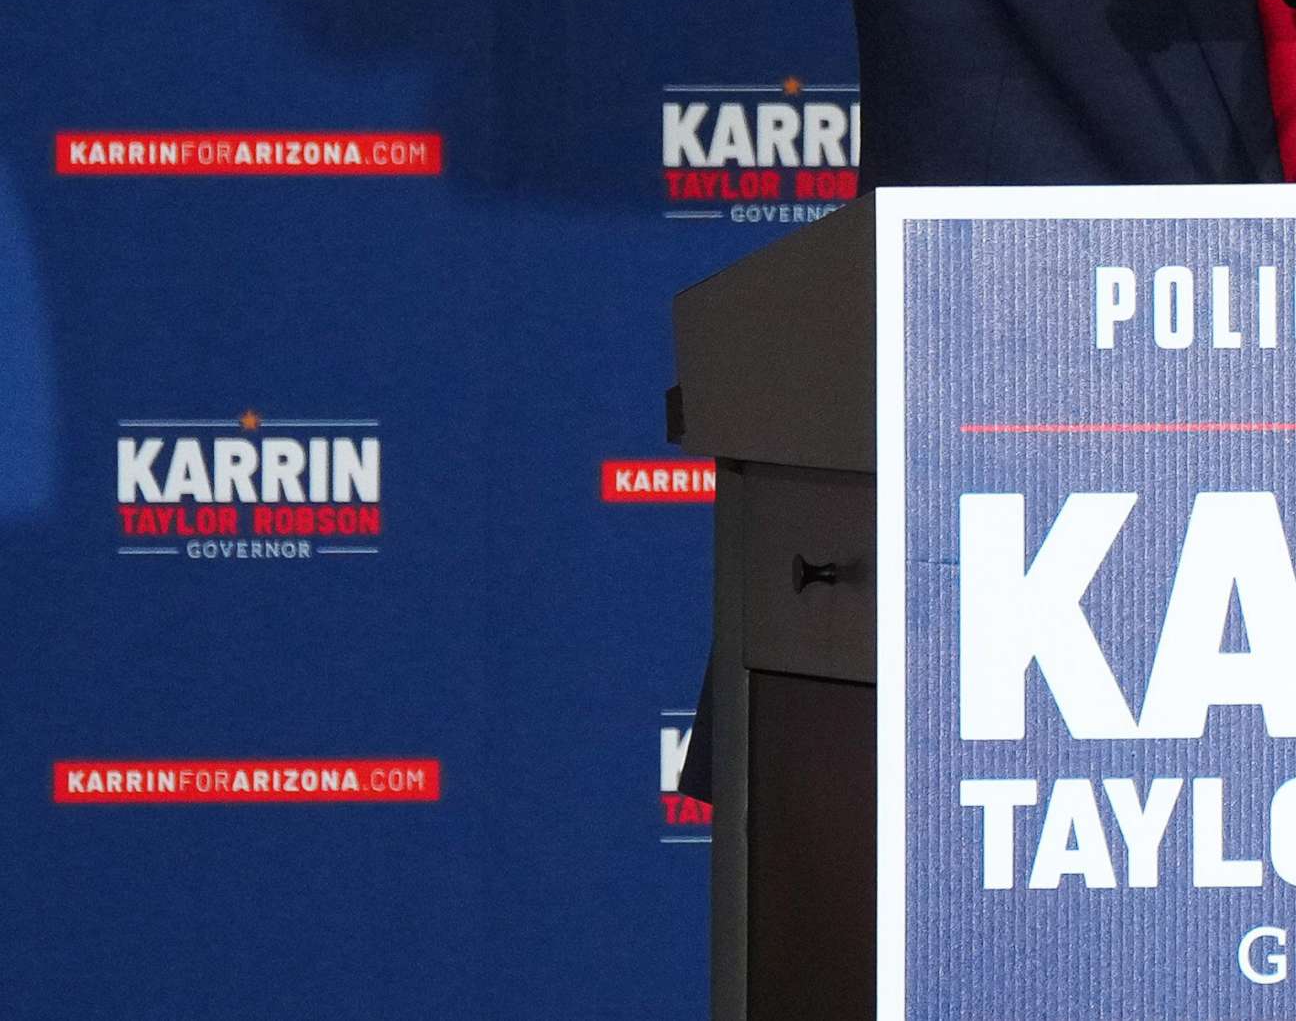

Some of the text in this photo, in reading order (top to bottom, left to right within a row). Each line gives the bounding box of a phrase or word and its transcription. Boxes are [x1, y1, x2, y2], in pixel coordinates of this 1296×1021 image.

[70, 141, 426, 166] KARRINFORARIZONA.COM
[666, 170, 781, 200] TAYLOR
[117, 438, 380, 503] KARRIN
[119, 506, 380, 535] TAYLOR ROBSON
[186, 540, 311, 559] GOVERNOR
[67, 768, 425, 793] KARRINFORARIZONA.COM
